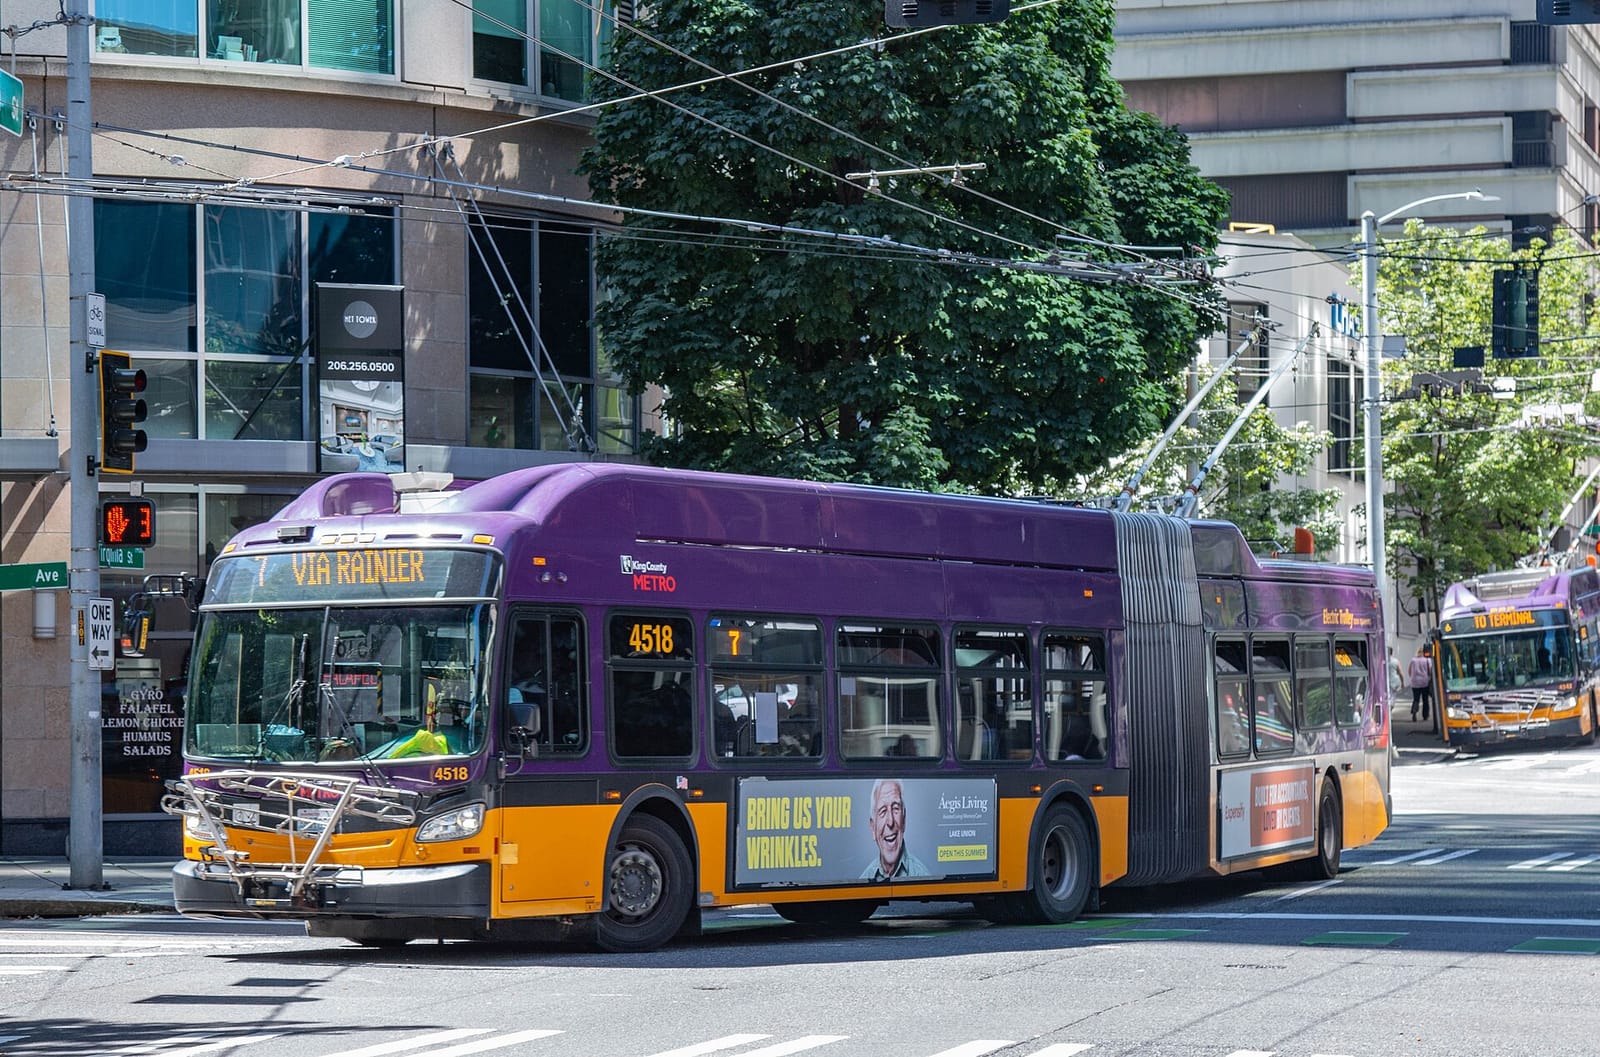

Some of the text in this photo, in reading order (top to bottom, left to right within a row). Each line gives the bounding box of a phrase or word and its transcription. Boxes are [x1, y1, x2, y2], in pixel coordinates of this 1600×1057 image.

[327, 360, 395, 372] 206.256.0500
[140, 507, 151, 538] 3
[100, 547, 123, 566] irginia
[251, 549, 425, 587] 7 VIA RAINIER
[632, 560, 667, 574] King County
[35, 569, 60, 583] Ave
[633, 574, 677, 592] METRO
[91, 604, 111, 620] ONE
[1474, 615, 1487, 629] TO
[91, 623, 111, 640] WAY
[629, 624, 674, 653] 4518
[728, 630, 740, 656] 7
[130, 688, 164, 700] GYRO
[120, 704, 175, 714] FALAFEL
[101, 717, 185, 728] LEMON CHICKE
[123, 731, 172, 742] HUMMUS
[123, 745, 172, 756] SALADS
[434, 767, 469, 780] 4518
[300, 786, 340, 799] MTRO
[962, 795, 988, 813] Living
[746, 796, 851, 830] BRING US YOUR
[960, 829, 976, 837] UNION
[746, 834, 822, 869] WRINKLES.
[939, 848, 985, 857] OPEN THIS SUMMER
